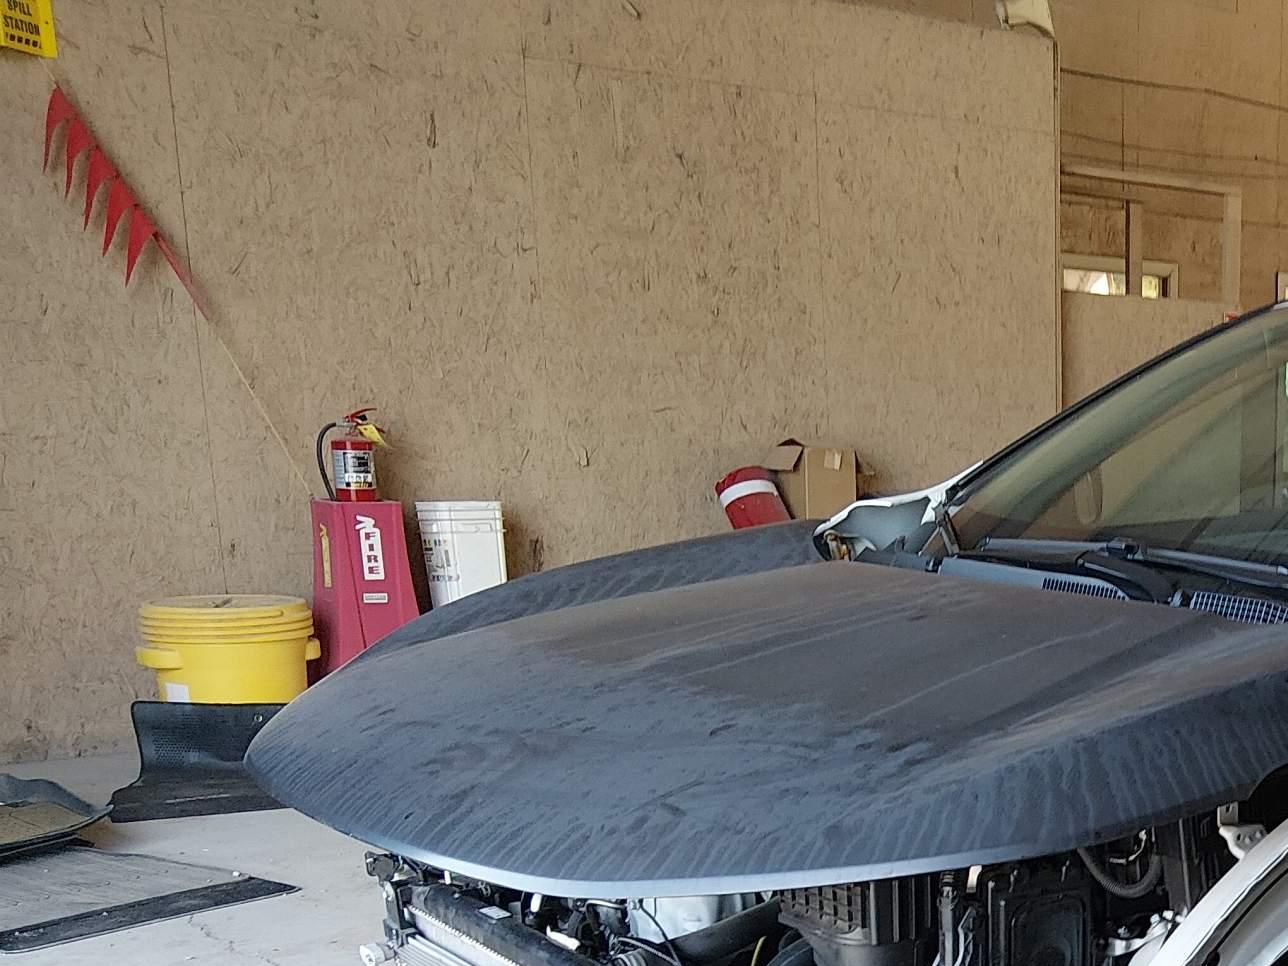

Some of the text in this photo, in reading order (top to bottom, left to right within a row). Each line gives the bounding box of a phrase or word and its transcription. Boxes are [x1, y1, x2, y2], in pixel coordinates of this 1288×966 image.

[8, 0, 32, 16] SPILL
[4, 15, 40, 36] STATION
[363, 530, 382, 576] FIRE
